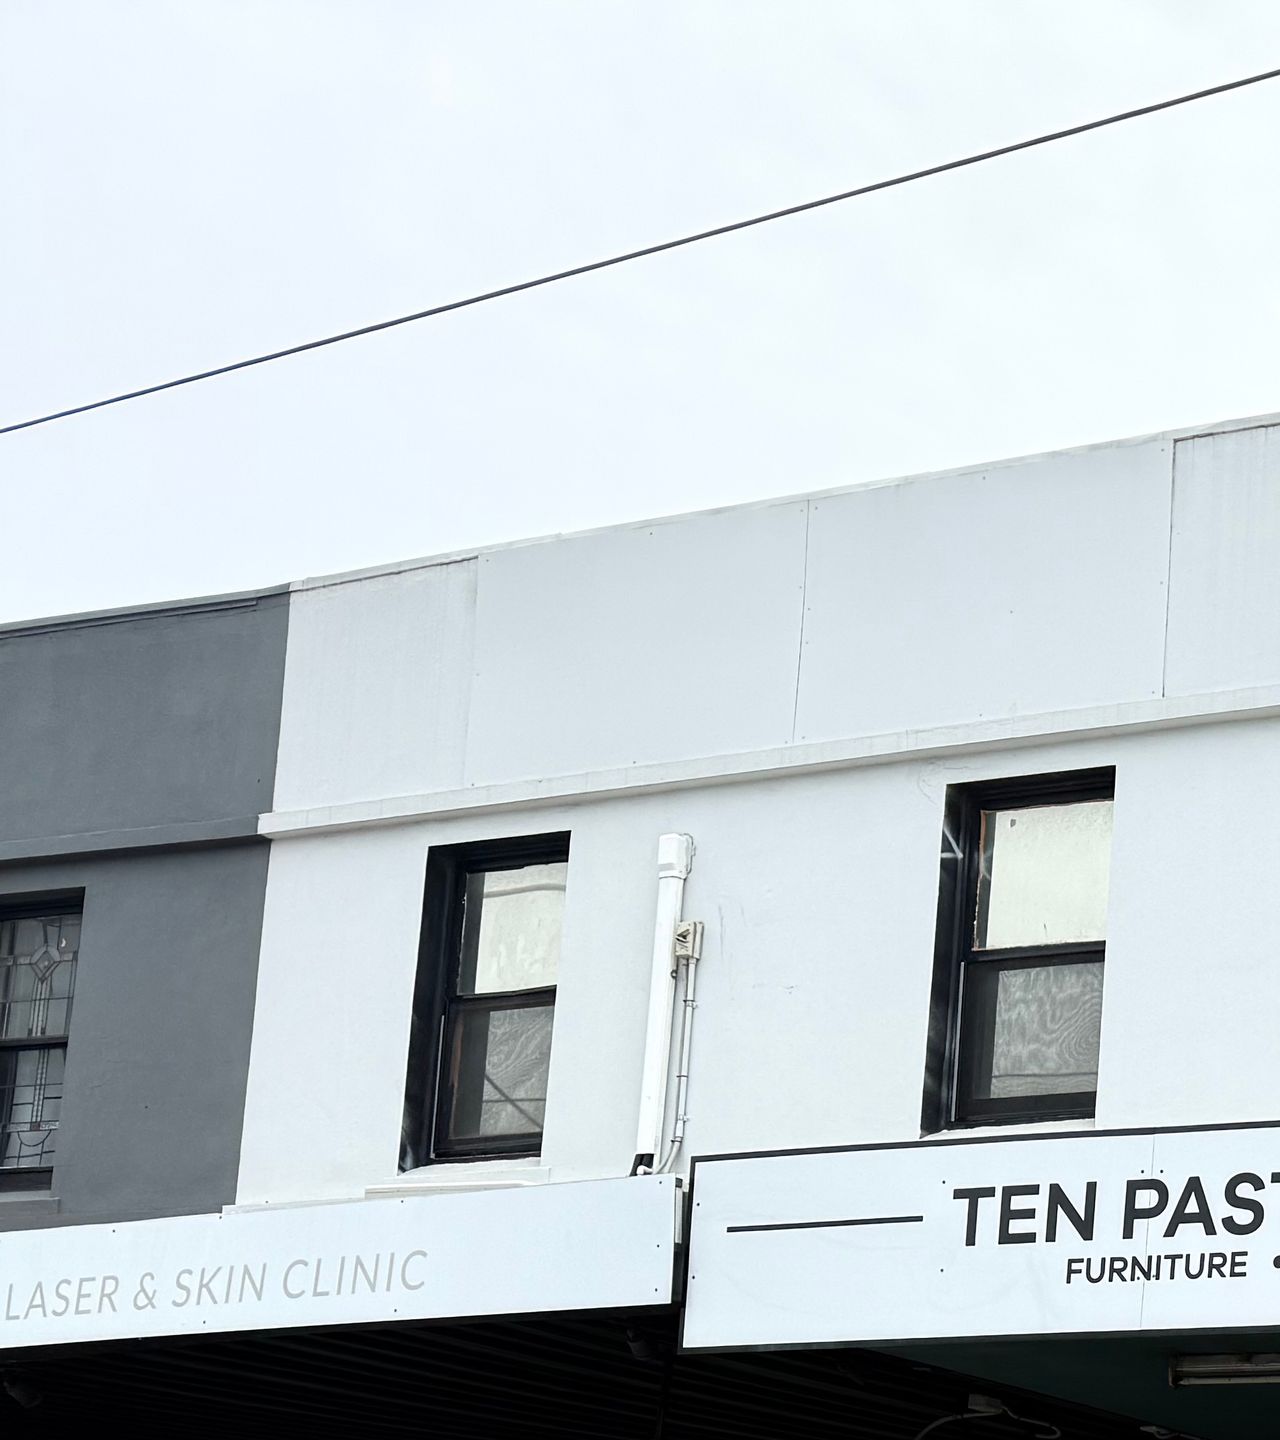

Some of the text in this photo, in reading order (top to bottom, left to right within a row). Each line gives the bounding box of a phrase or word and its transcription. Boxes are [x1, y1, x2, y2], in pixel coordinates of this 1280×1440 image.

[951, 1180, 1098, 1248] TEN
[5, 1249, 428, 1321] LASER & SKIN CLINIC
[1065, 1250, 1249, 1285] FURNITURE
